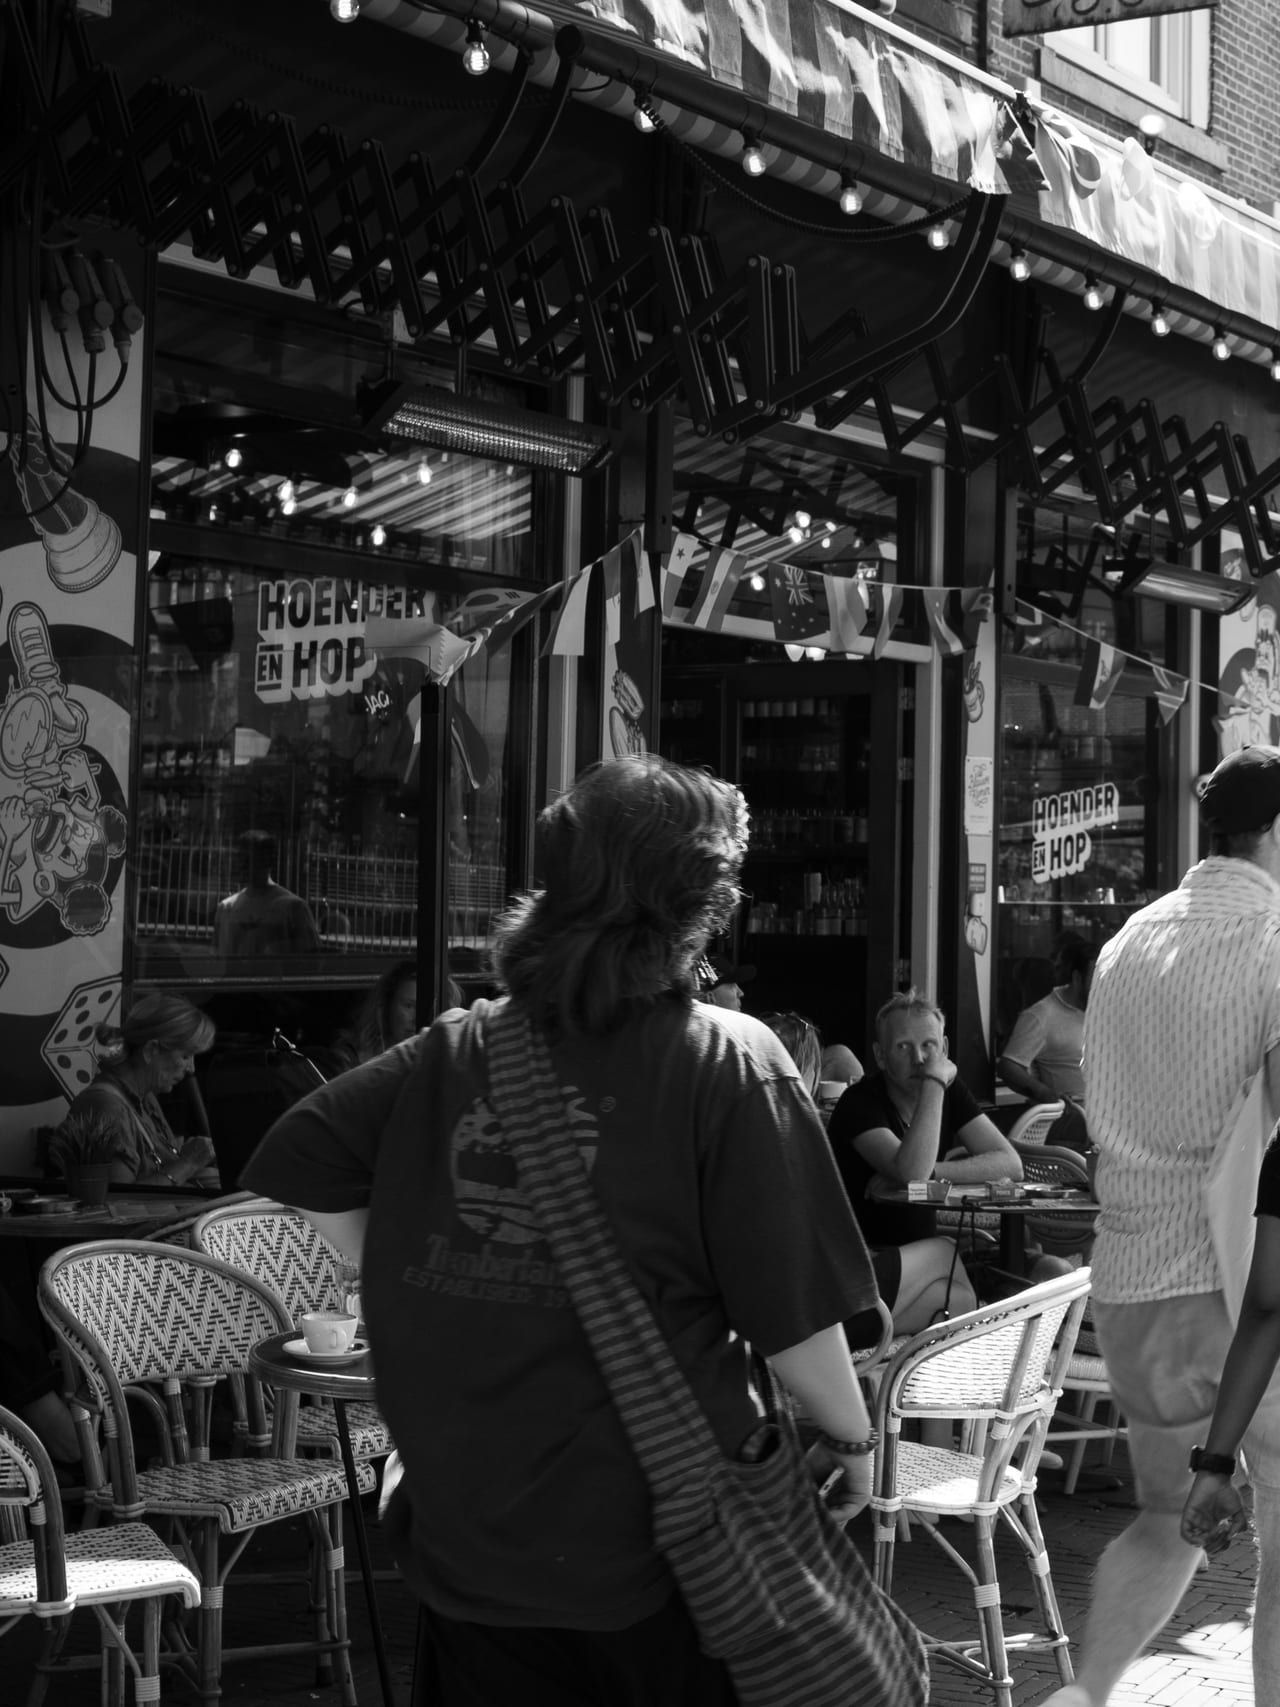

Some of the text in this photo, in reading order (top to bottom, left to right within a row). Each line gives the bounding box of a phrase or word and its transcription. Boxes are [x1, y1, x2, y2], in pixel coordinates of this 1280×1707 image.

[257, 636, 367, 688] EN HOP
[1034, 784, 1116, 834] HOENDER
[1050, 831, 1088, 872] HOP
[424, 1233, 563, 1286] Timberlan
